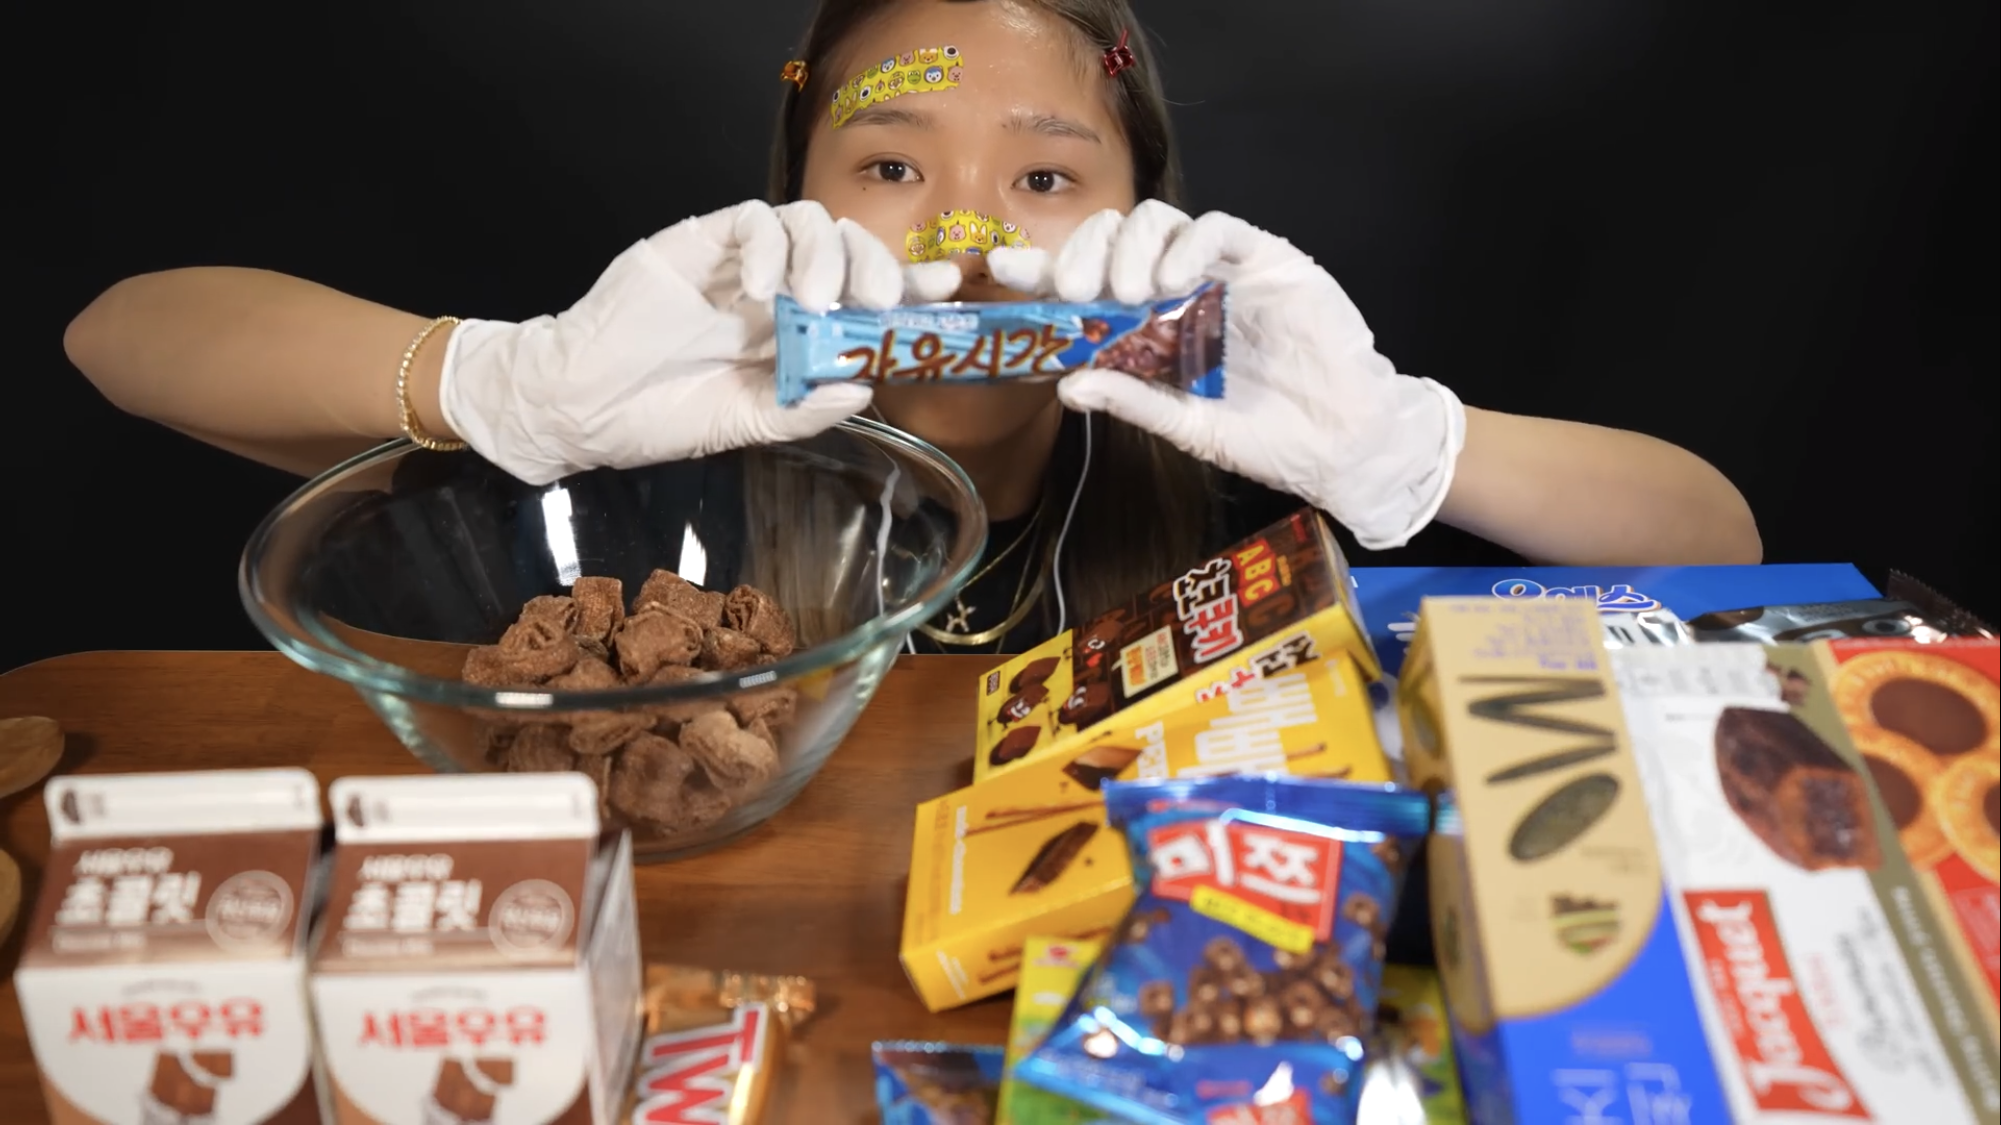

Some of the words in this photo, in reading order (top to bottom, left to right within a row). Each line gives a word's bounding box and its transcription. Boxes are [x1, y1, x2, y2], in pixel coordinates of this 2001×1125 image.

[1235, 544, 1274, 601] ABC
[1174, 557, 1243, 663] 초코쿠키
[1150, 819, 1322, 905] 미쯔
[68, 998, 264, 1044] 서울우유
[358, 1004, 547, 1048] 서울우유
[1697, 898, 1853, 1111] Jacquet
